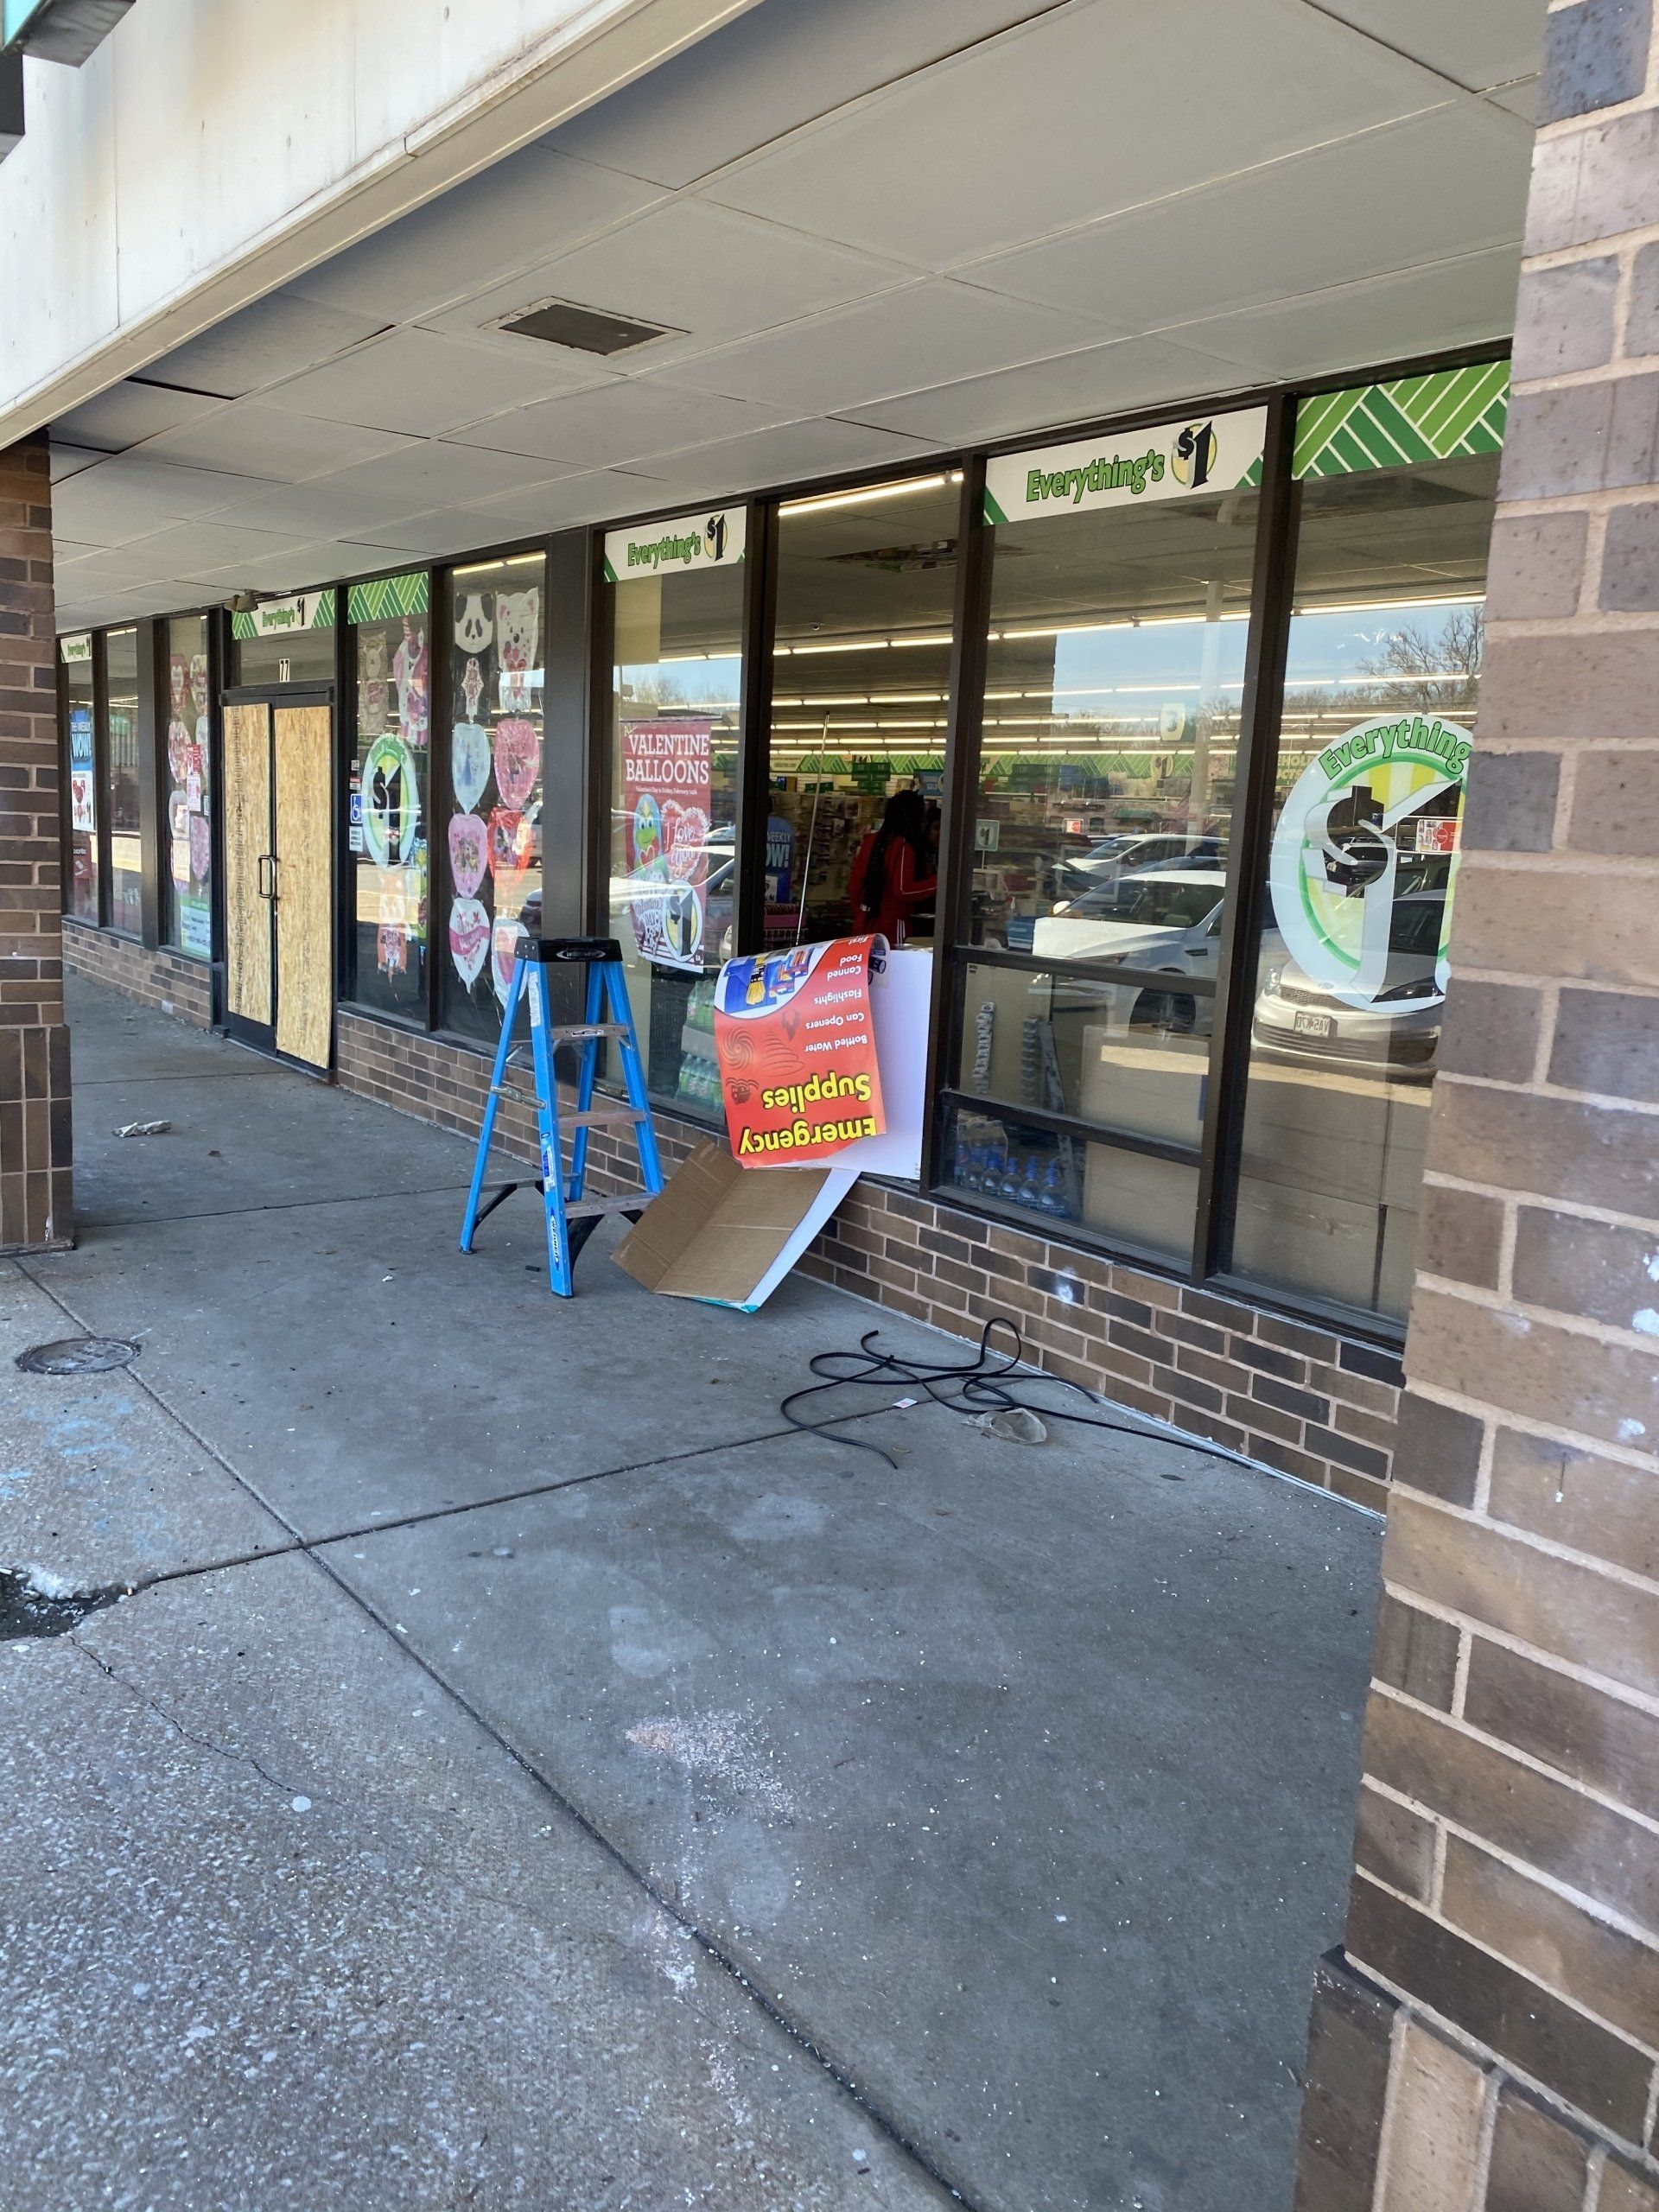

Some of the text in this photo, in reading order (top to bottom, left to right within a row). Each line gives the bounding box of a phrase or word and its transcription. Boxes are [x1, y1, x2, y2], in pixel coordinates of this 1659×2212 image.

[1026, 420, 1213, 504] Everything's $1
[627, 512, 725, 569] Everything's $1
[280, 659, 289, 682] 77
[628, 734, 709, 756] VALENTINE
[625, 759, 709, 785] BALLOONS
[839, 953, 863, 967] Food
[826, 965, 861, 982] Canned
[814, 988, 862, 1005] Flashlights
[804, 1012, 865, 1030] Can Openers
[804, 1034, 868, 1052] Bottled Water
[761, 1071, 872, 1114] Supplies
[739, 1116, 877, 1155] Emergency
